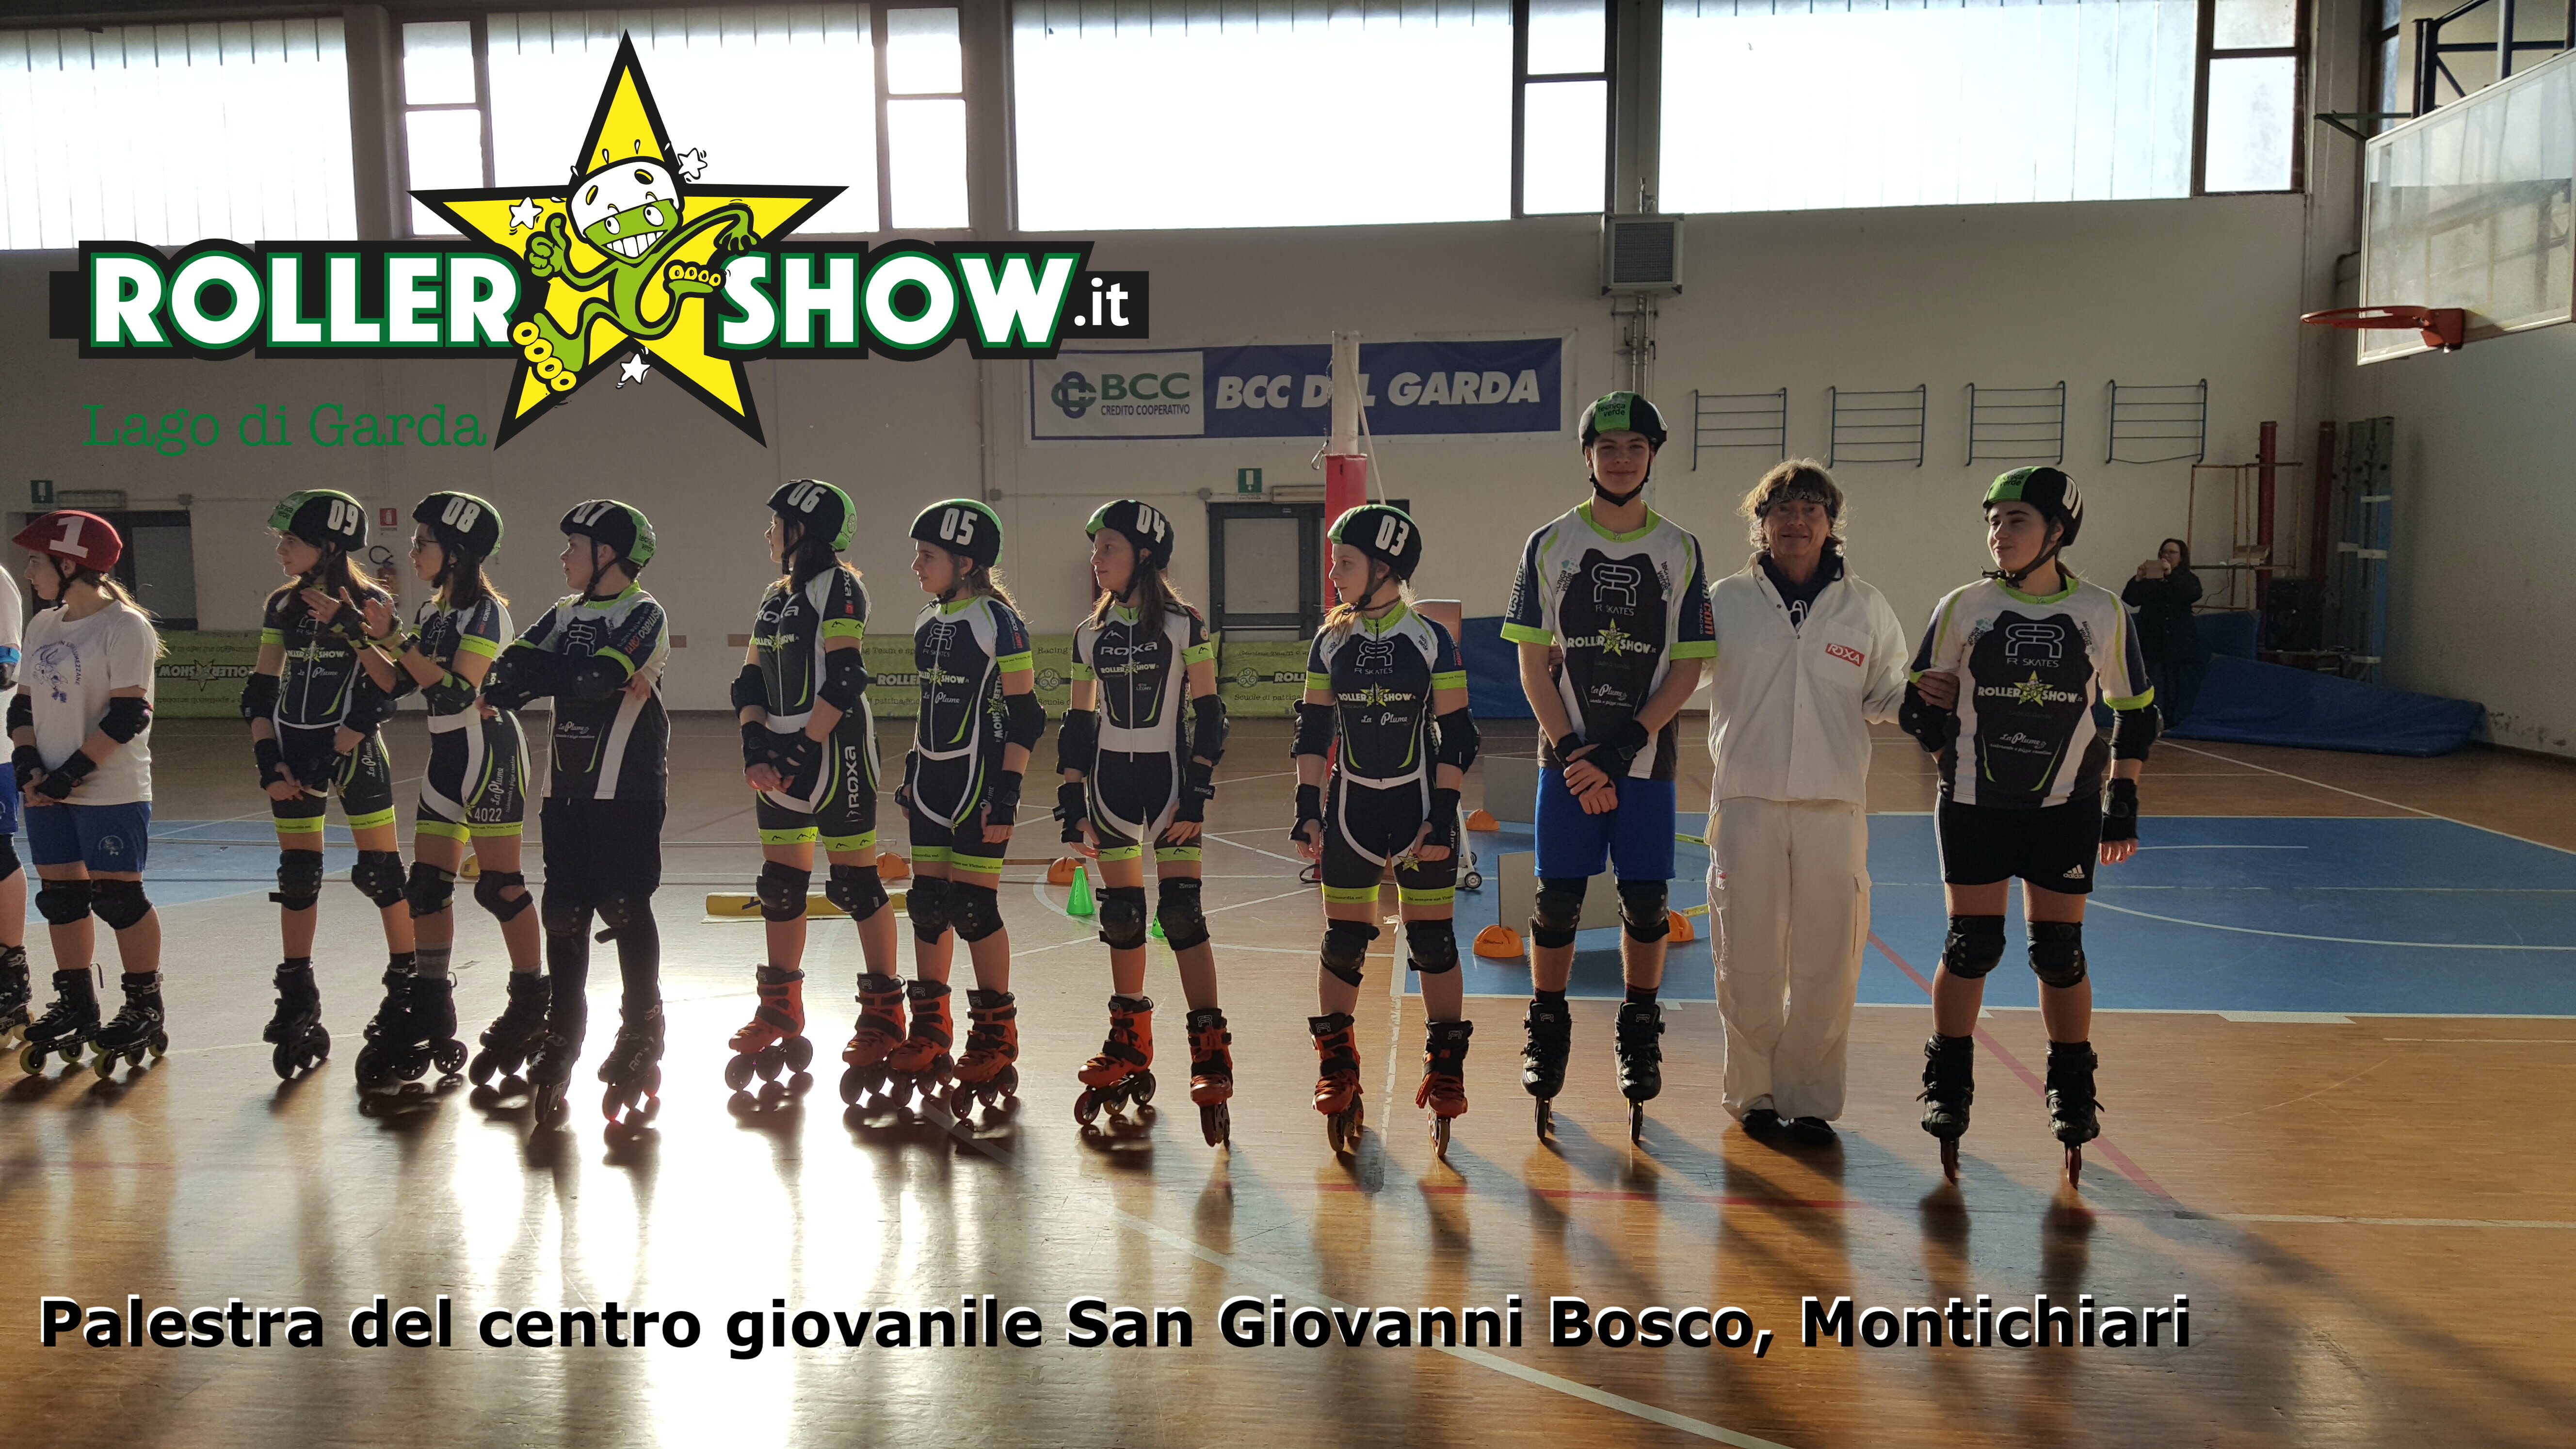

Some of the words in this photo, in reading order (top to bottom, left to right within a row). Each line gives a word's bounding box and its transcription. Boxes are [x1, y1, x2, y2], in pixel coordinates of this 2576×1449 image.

[1101, 372, 1190, 400] BCC
[1216, 375, 1291, 409] BCC
[1301, 373, 1376, 407] DL
[1387, 369, 1540, 406] GARDA
[1101, 404, 1134, 416] CREDITO
[1136, 403, 1190, 416] COOPERATIVO
[1604, 409, 1625, 417] verde
[787, 482, 827, 513] 06
[327, 499, 358, 536] 09
[441, 497, 481, 533] 08
[1136, 504, 1165, 544] 04
[939, 508, 978, 546] 05
[1375, 515, 1409, 556] 03
[49, 515, 88, 559] 1
[1828, 644, 1860, 664] ROXA
[2022, 658, 2060, 668] SKATES
[876, 674, 920, 685] ROLLE
[941, 675, 966, 684] SHOW
[1274, 673, 1306, 682] ROLL
[934, 692, 960, 704] Plume
[1337, 693, 1367, 701] ROLLER
[1383, 692, 1412, 701] SHOW
[1978, 686, 2022, 697] ROLLER
[2041, 690, 2078, 703] SHOW
[1361, 714, 1372, 723] La
[1380, 712, 1408, 726] Plume
[488, 767, 505, 794] Plume
[474, 807, 502, 822] 4022
